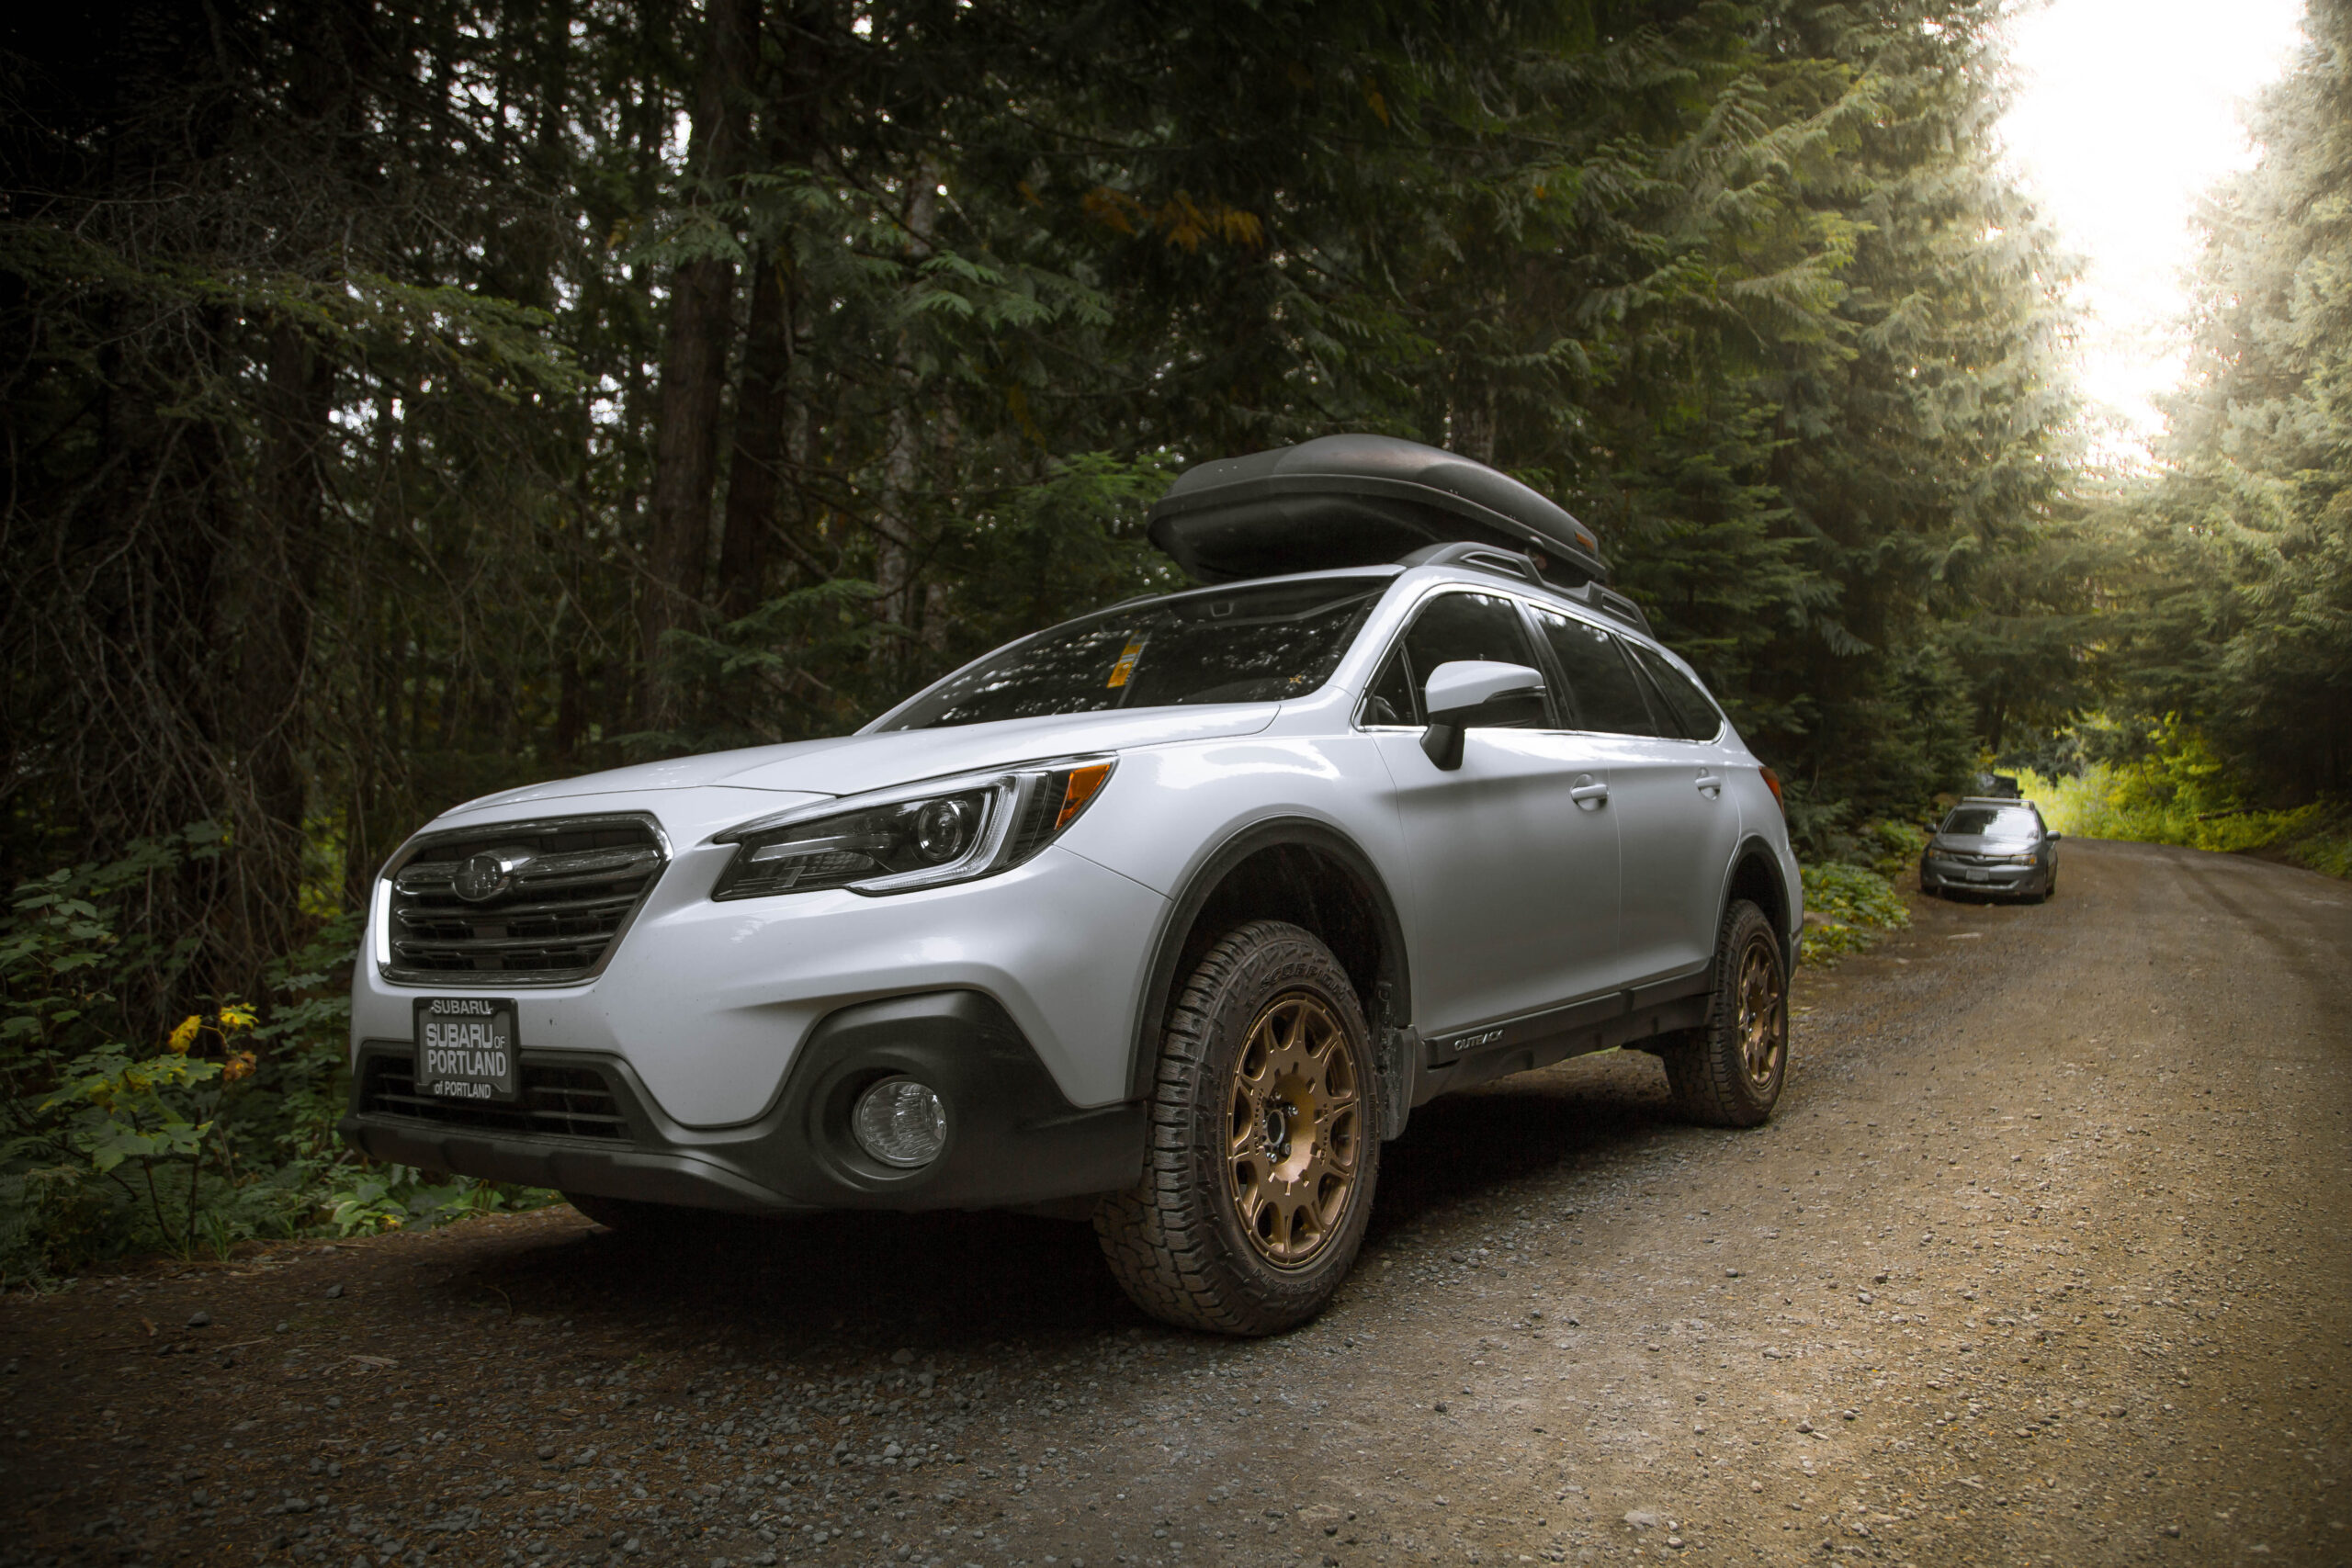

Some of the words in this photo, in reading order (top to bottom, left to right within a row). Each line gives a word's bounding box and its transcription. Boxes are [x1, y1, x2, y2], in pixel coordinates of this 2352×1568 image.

[432, 999, 491, 1015] SUBARU
[426, 1022, 493, 1049] SUBARU
[494, 1035, 505, 1049] OF
[1454, 1029, 1504, 1052] OUTBACK
[427, 1049, 507, 1077] PORTLAND
[435, 1080, 444, 1095] of
[445, 1080, 492, 1100] PORTLAND
